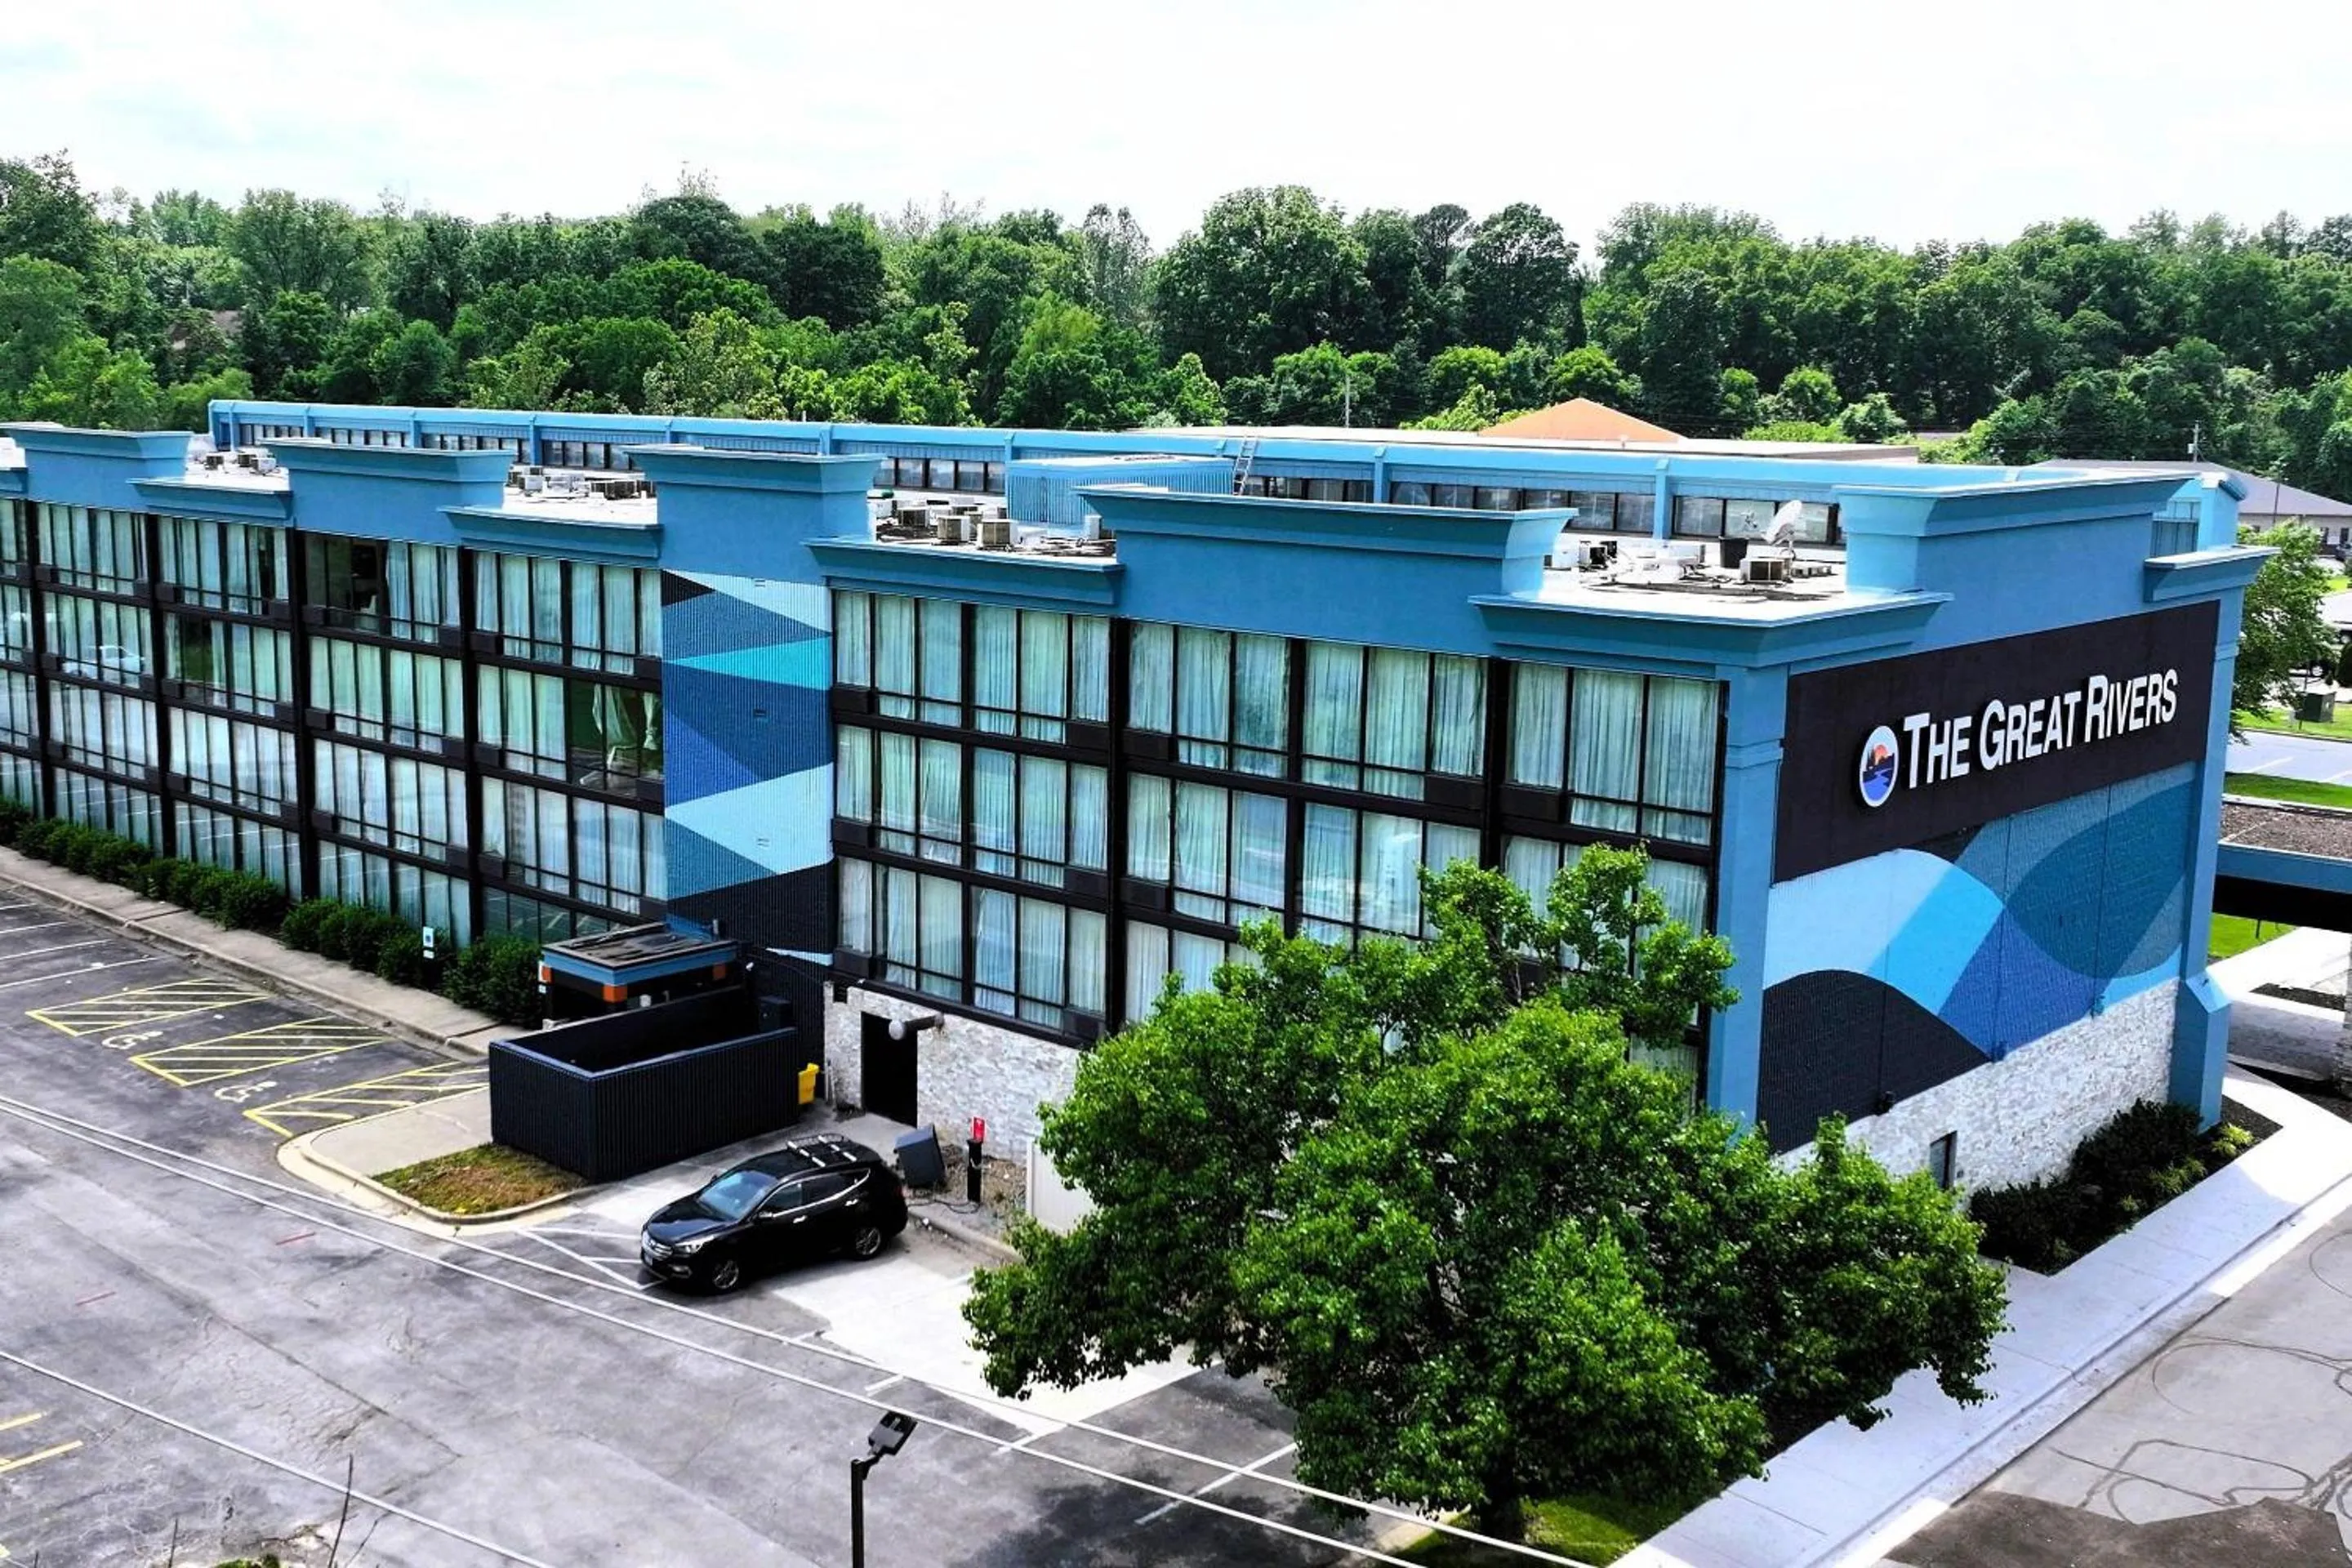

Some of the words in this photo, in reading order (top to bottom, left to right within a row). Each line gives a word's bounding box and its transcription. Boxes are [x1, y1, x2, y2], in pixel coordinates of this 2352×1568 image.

[1903, 712, 1972, 789] THE
[1980, 690, 2082, 771] GREAT
[2084, 669, 2179, 743] RIVERS
